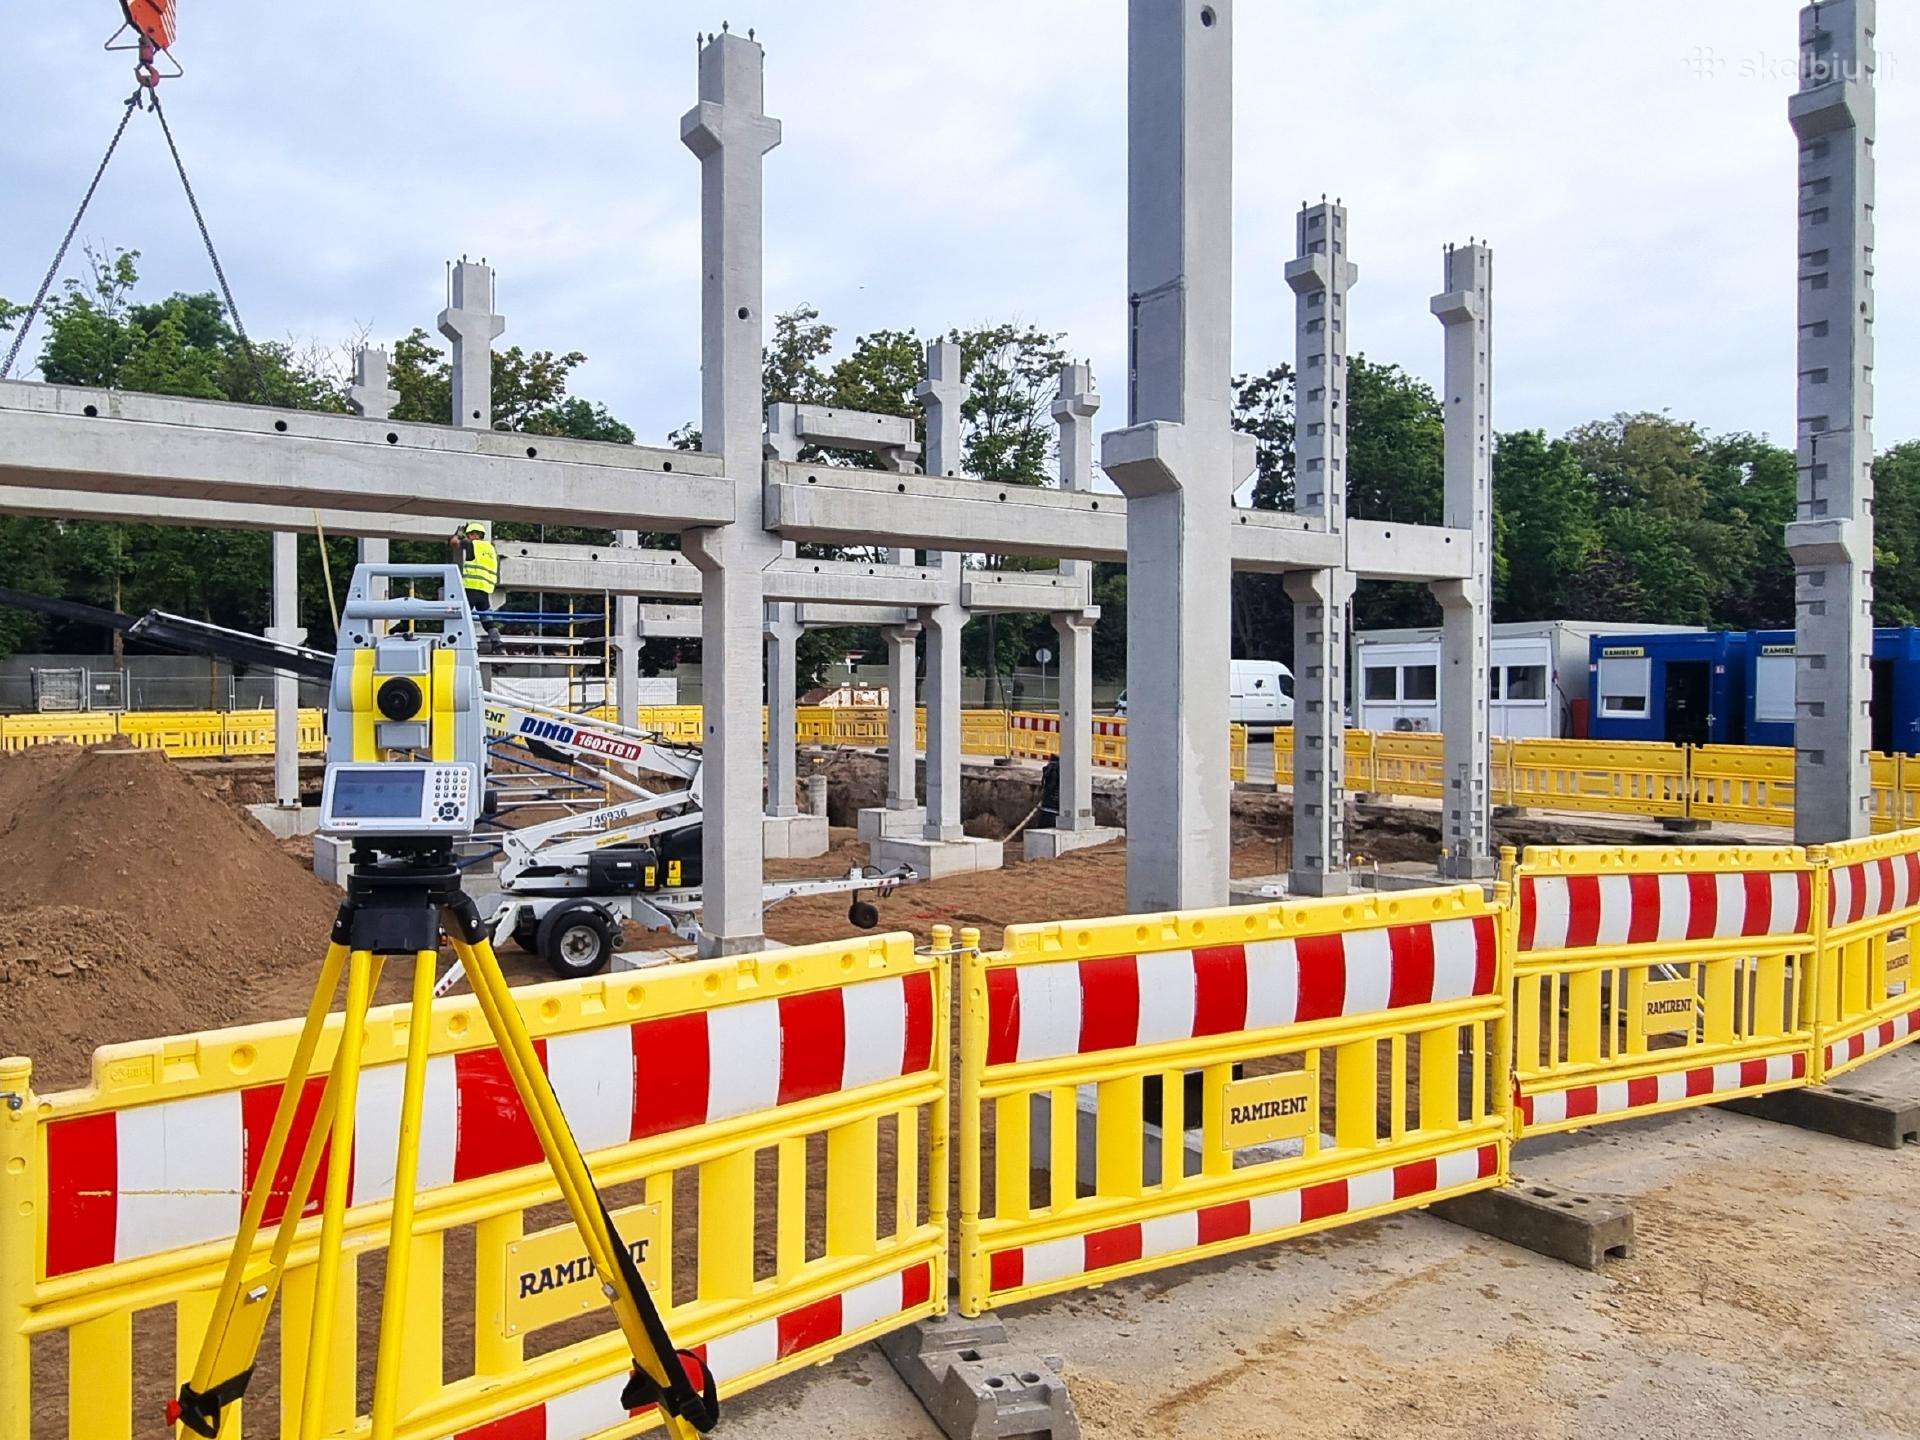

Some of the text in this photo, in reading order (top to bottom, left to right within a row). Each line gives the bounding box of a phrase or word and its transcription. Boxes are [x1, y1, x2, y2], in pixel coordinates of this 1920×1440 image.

[1762, 647, 1795, 655] RAMIRE
[519, 716, 574, 744] DINO
[586, 808, 628, 829] 746936
[1647, 998, 1693, 1016] RAMIRENT
[1230, 1095, 1308, 1125] RAMIRENT
[519, 1238, 649, 1299] RAMIT
